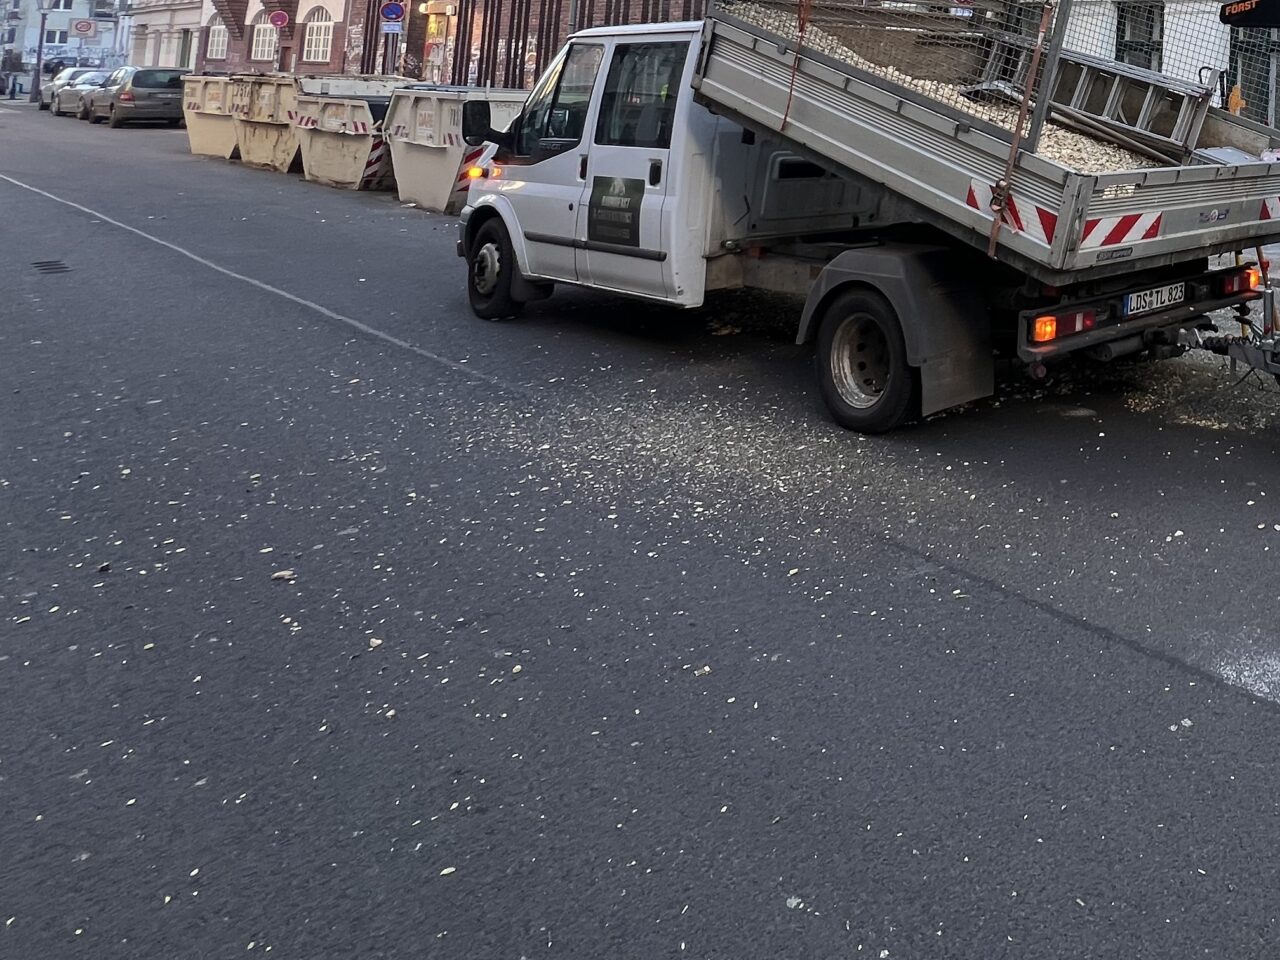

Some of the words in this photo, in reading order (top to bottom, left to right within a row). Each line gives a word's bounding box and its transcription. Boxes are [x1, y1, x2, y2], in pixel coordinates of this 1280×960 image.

[1128, 292, 1149, 313] LDS
[1154, 289, 1166, 306] TL
[1167, 283, 1185, 304] 823
